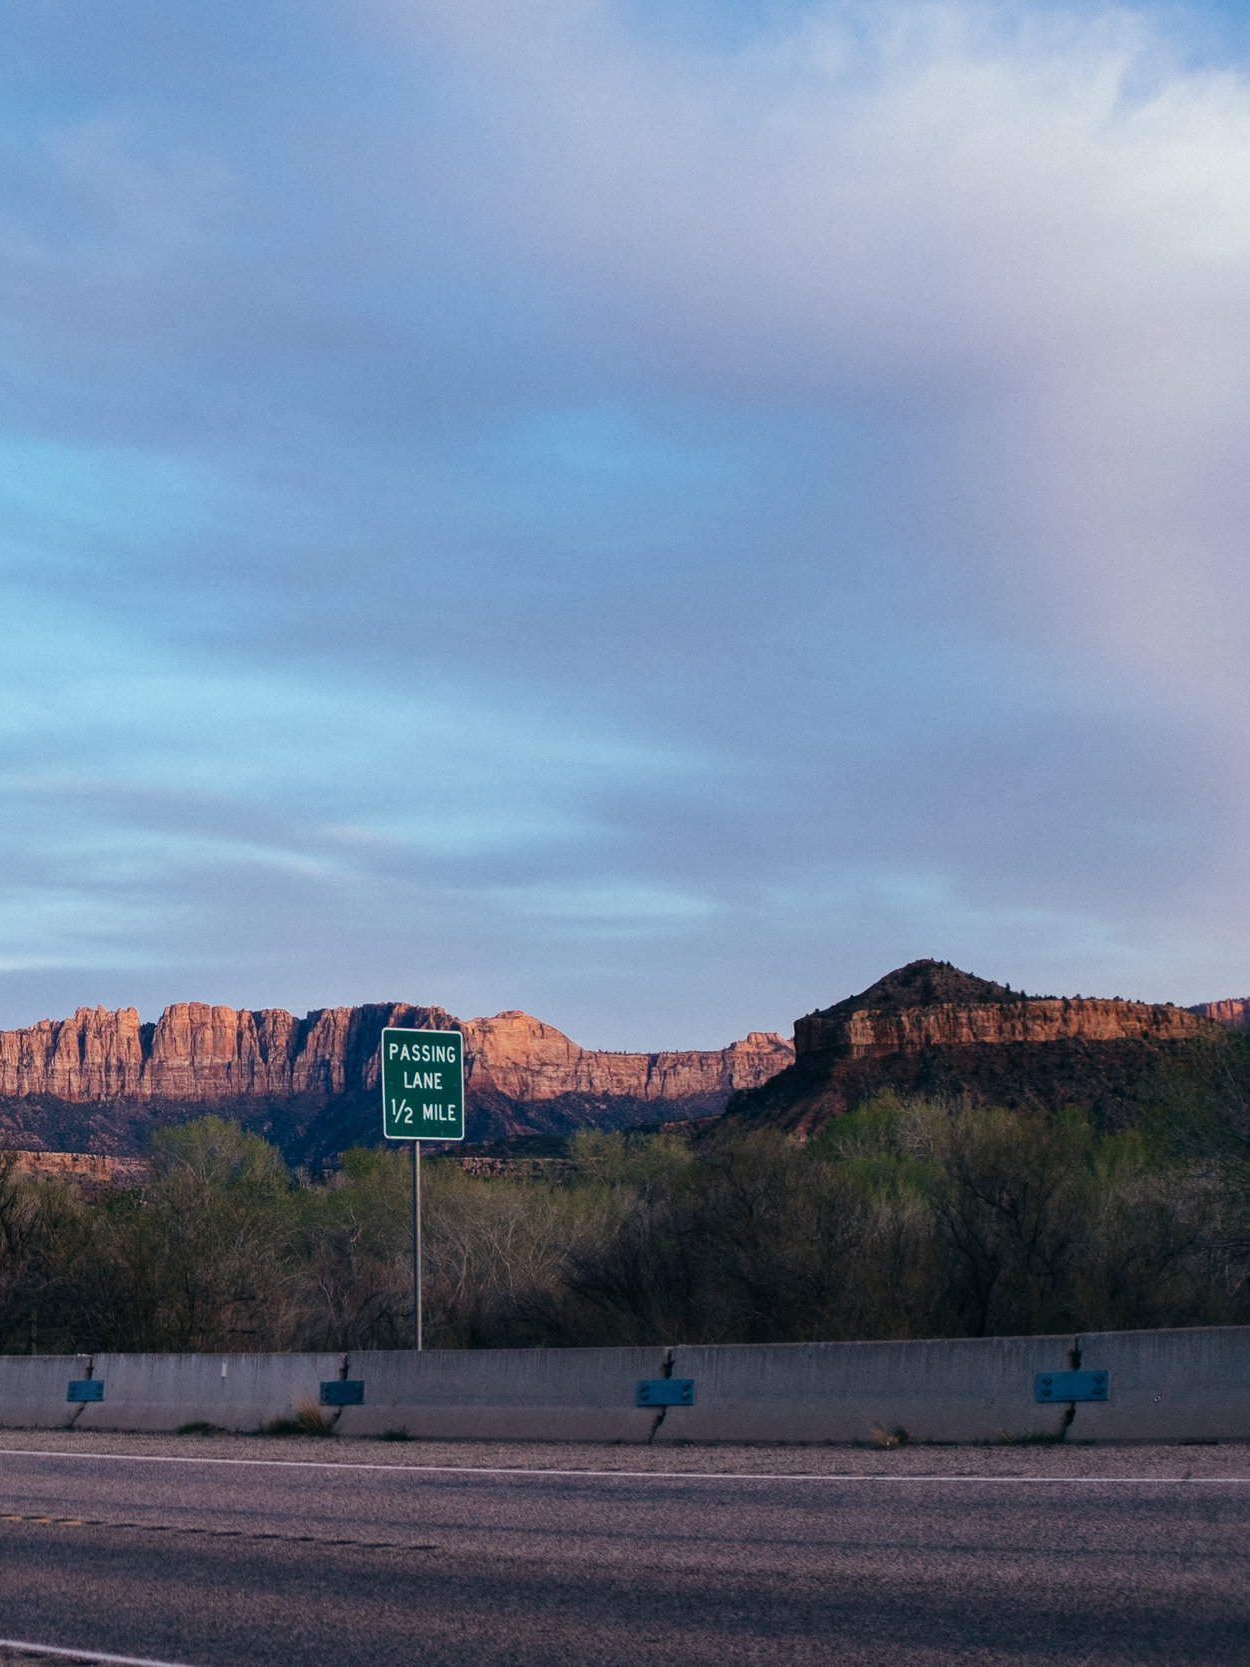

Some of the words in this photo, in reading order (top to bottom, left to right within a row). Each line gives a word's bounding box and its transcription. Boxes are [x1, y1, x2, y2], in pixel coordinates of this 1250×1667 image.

[389, 1043, 456, 1063] PASSING
[403, 1071, 443, 1090] LANE
[423, 1103, 456, 1121] MILE
